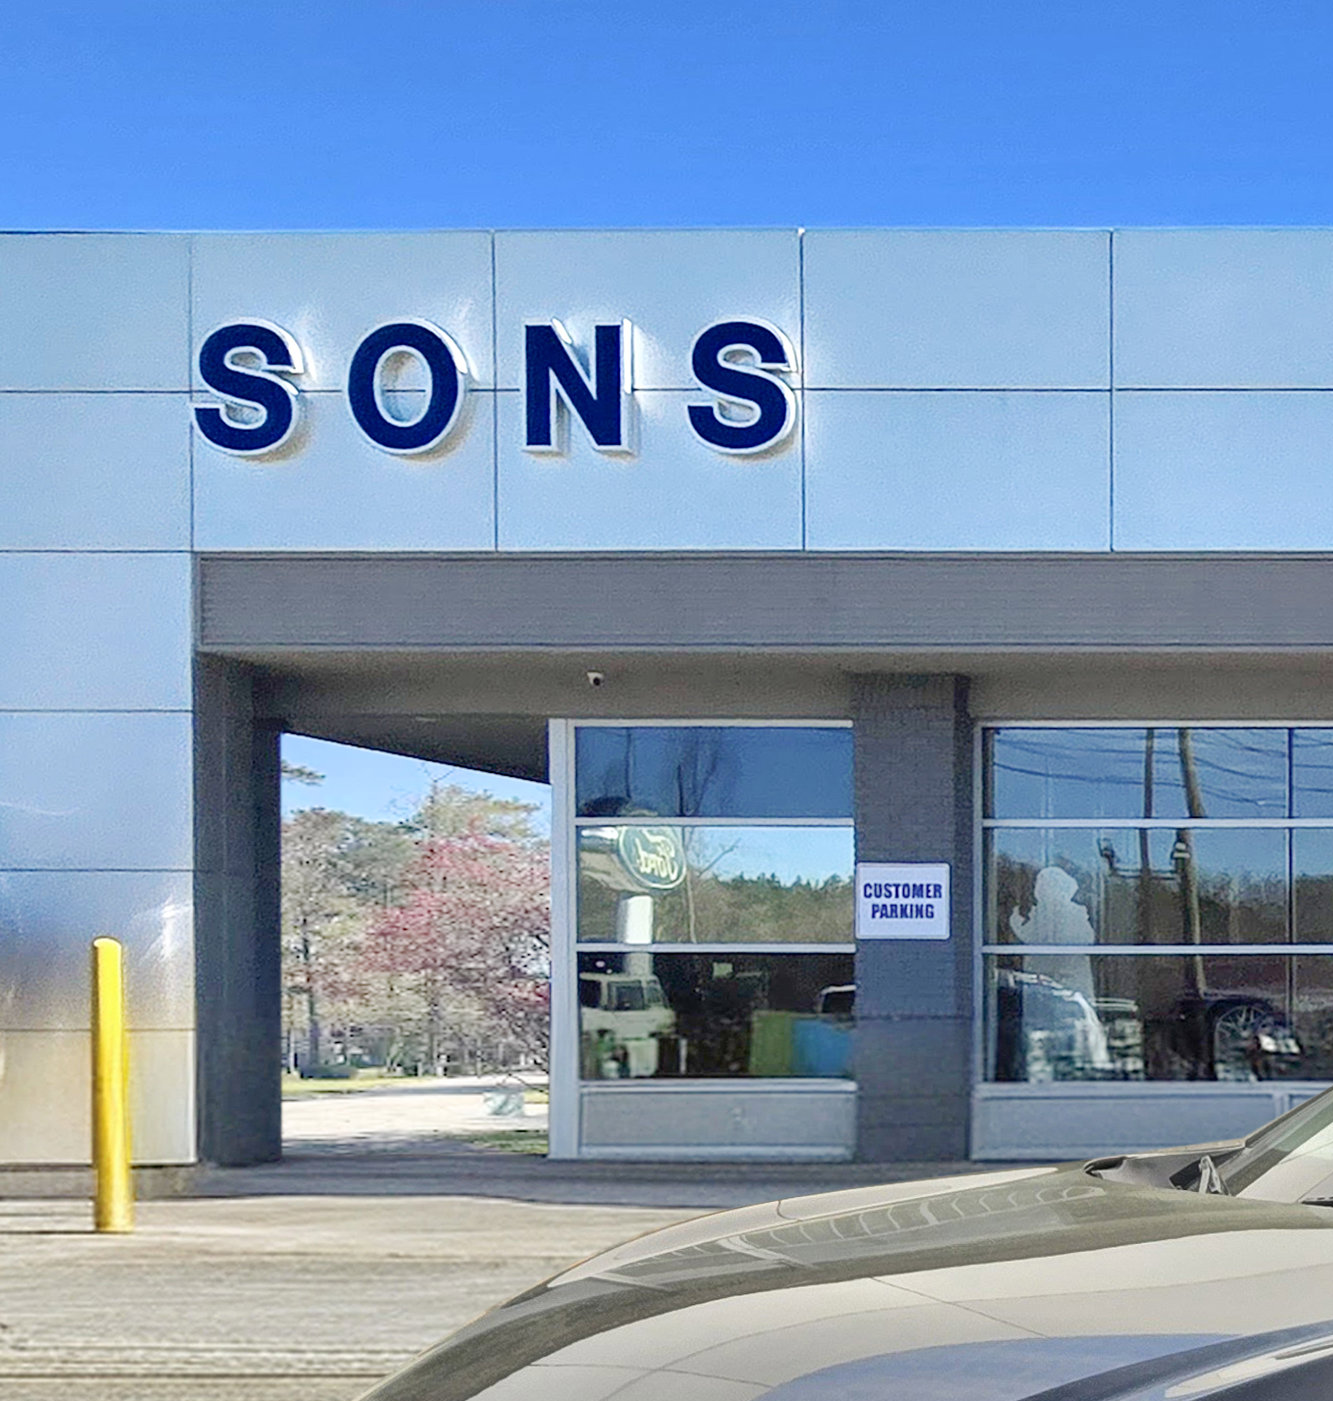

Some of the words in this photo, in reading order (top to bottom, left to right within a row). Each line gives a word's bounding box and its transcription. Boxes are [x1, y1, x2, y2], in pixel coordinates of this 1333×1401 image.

[193, 318, 800, 455] SONS
[863, 883, 943, 899] CUSTOMER
[871, 903, 935, 919] PARKING
